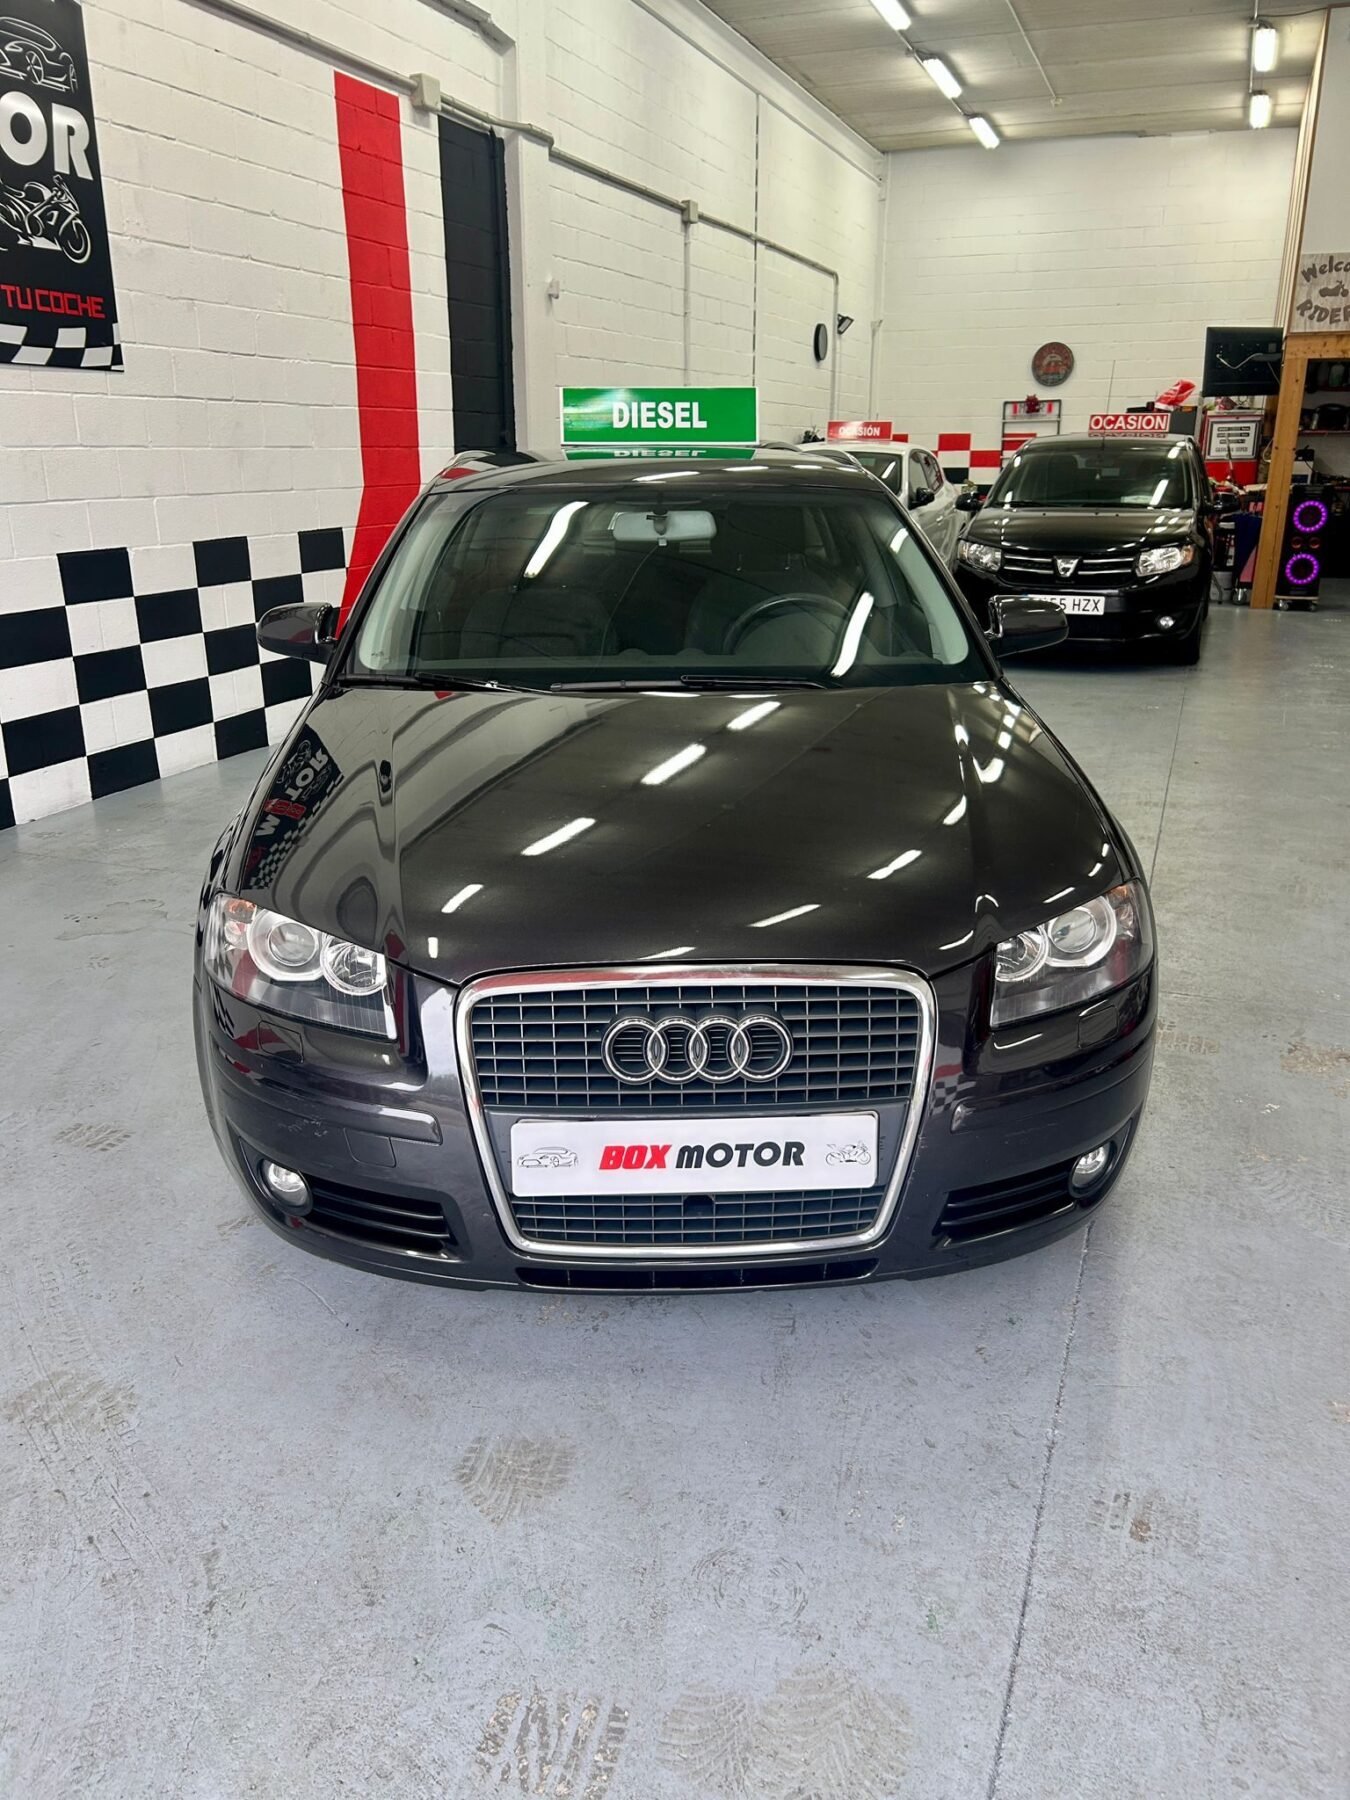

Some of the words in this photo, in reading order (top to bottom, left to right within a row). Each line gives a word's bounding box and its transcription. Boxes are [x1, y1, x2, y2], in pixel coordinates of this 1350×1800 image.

[0, 284, 33, 310] TU
[35, 288, 106, 318] COCHE
[613, 401, 707, 428] DIESEL
[1091, 415, 1167, 430] OCASION
[839, 425, 880, 437] OSIÓN
[1073, 599, 1101, 612] HZX
[598, 1144, 672, 1171] BOX
[675, 1141, 805, 1169] MOTOR
